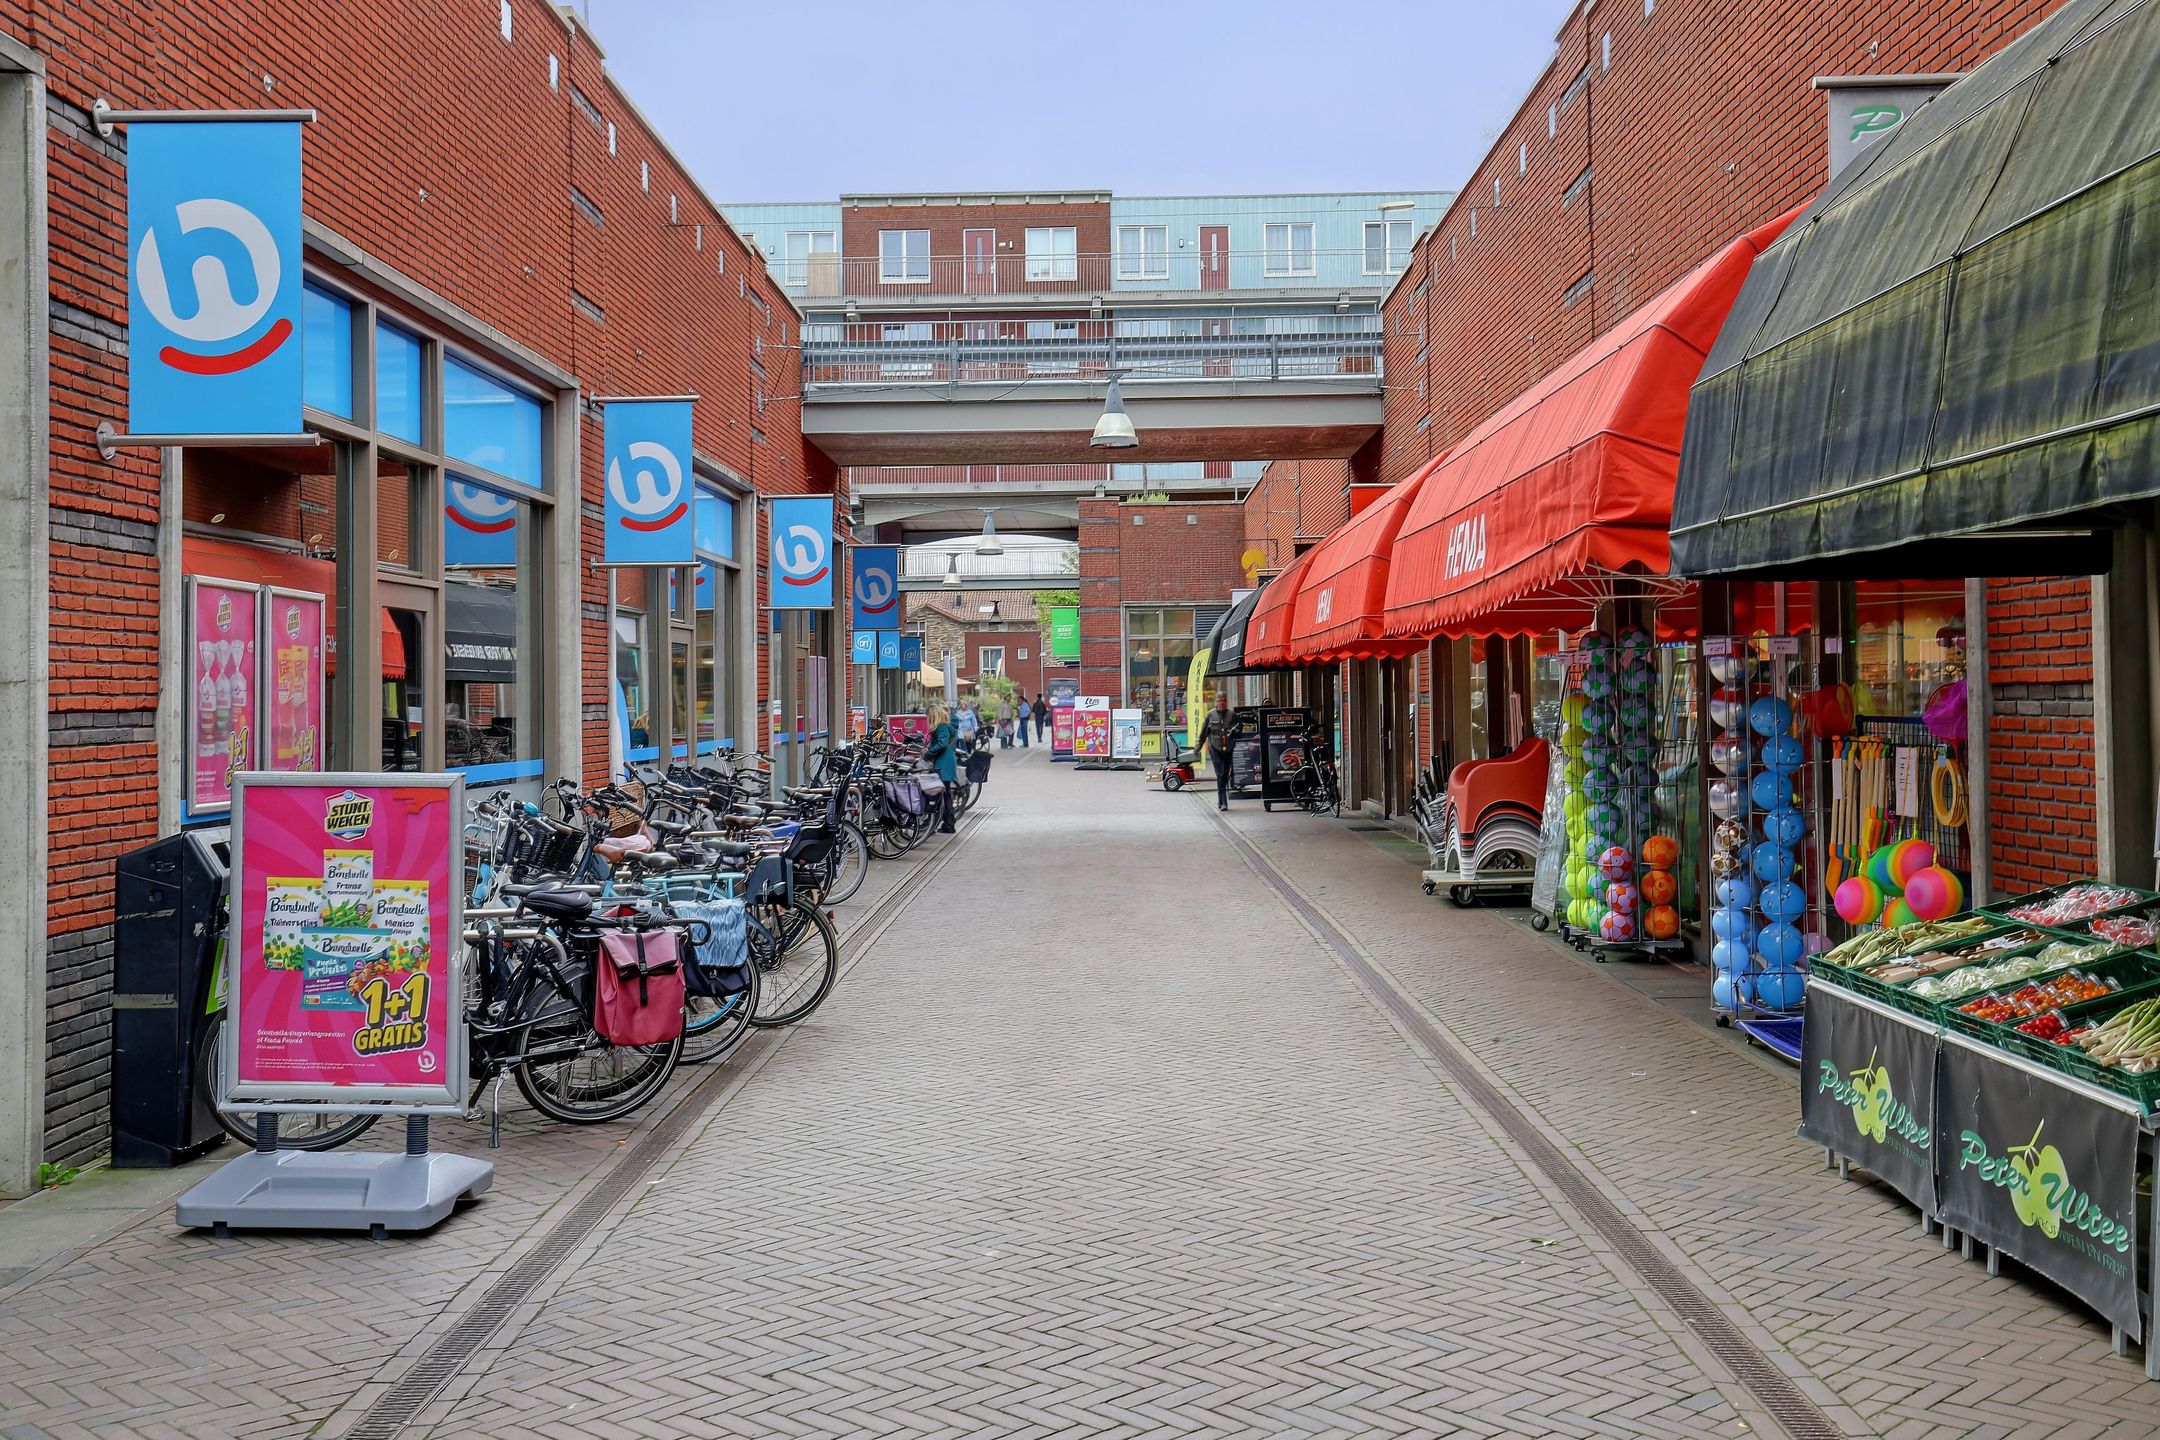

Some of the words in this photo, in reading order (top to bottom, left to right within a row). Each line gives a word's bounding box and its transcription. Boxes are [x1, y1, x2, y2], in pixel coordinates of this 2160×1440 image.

[1444, 513, 1487, 580] HEMA
[327, 813, 370, 829] WEKEN
[330, 801, 370, 817] STUNT
[361, 973, 427, 1025] 1+1
[354, 1021, 425, 1051] GRATIS
[1819, 1059, 1868, 1110] Peter
[1959, 1129, 2031, 1197] Peter
